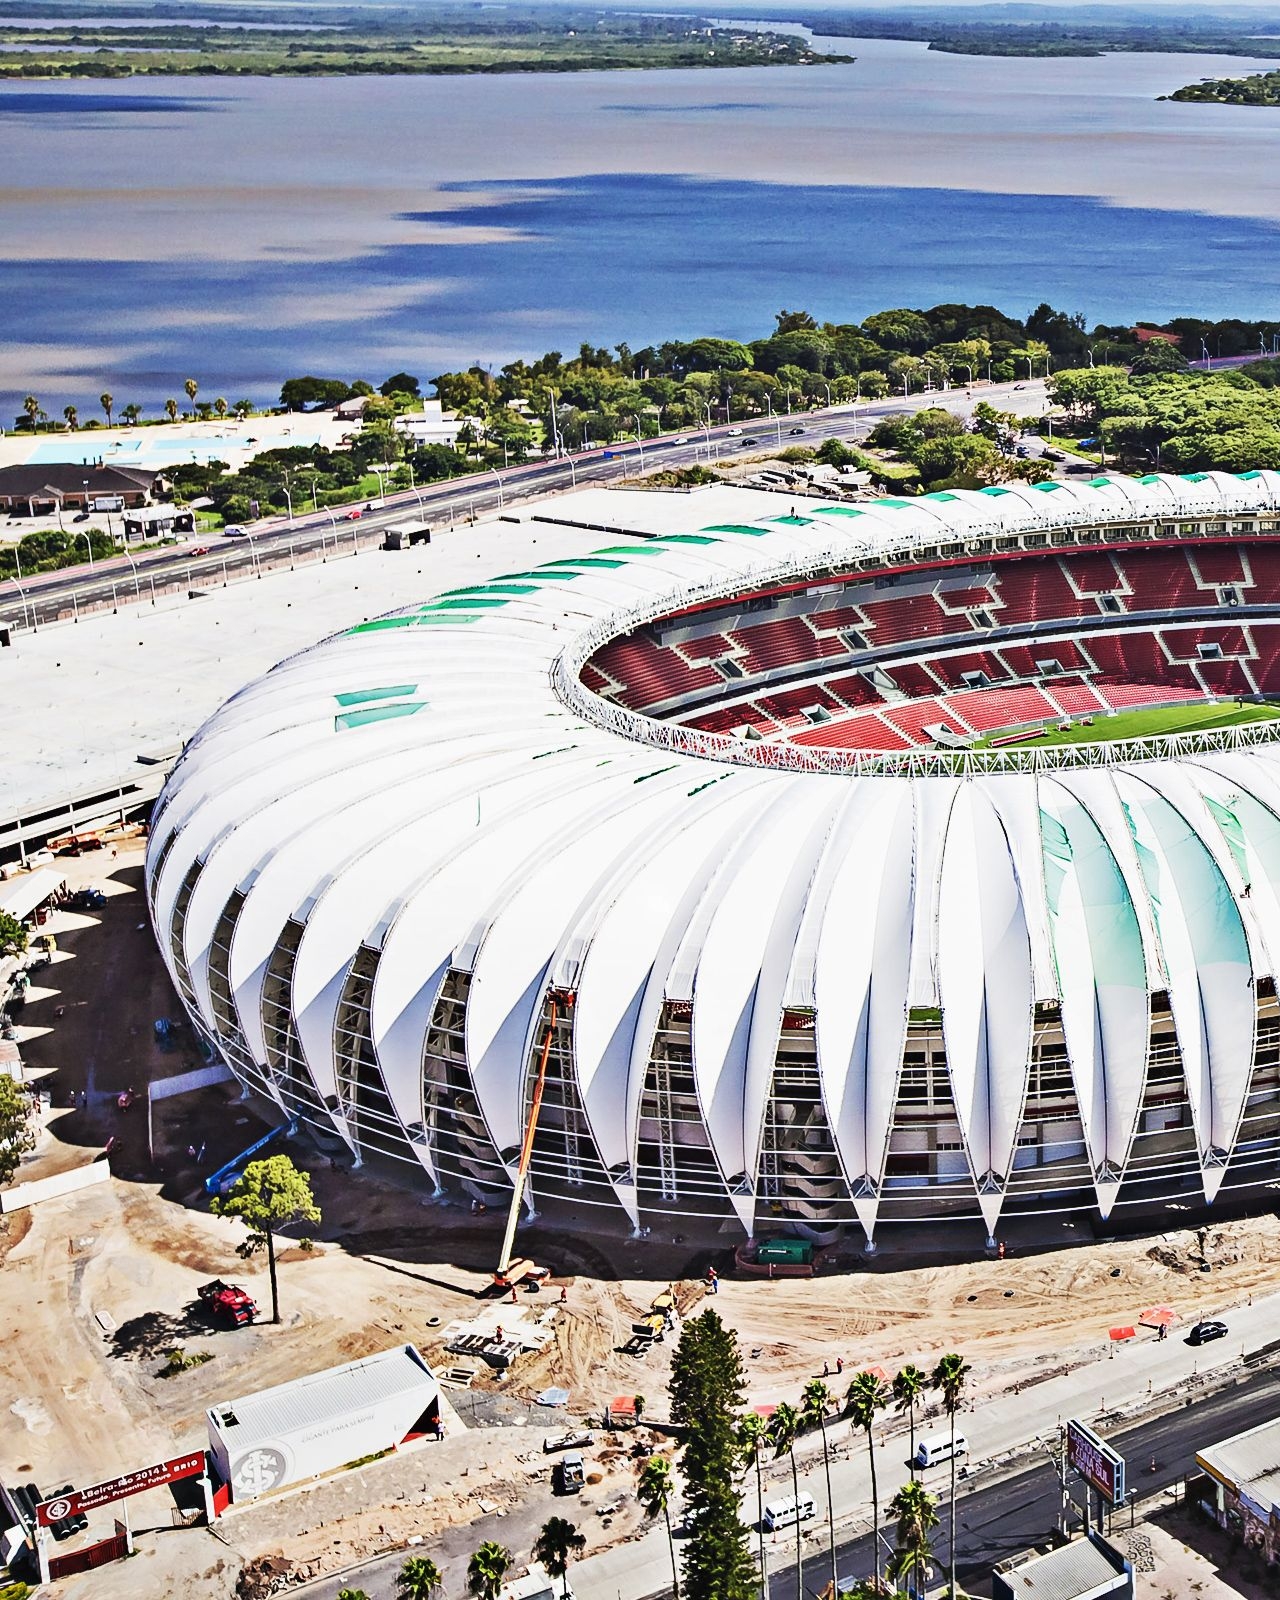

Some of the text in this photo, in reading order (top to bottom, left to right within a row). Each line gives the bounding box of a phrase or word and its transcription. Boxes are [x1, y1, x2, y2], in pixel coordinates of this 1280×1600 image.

[173, 1459, 198, 1473] BRIO
[86, 1466, 160, 1498] Beira-Ro 2014
[147, 1472, 172, 1485] Futuro
